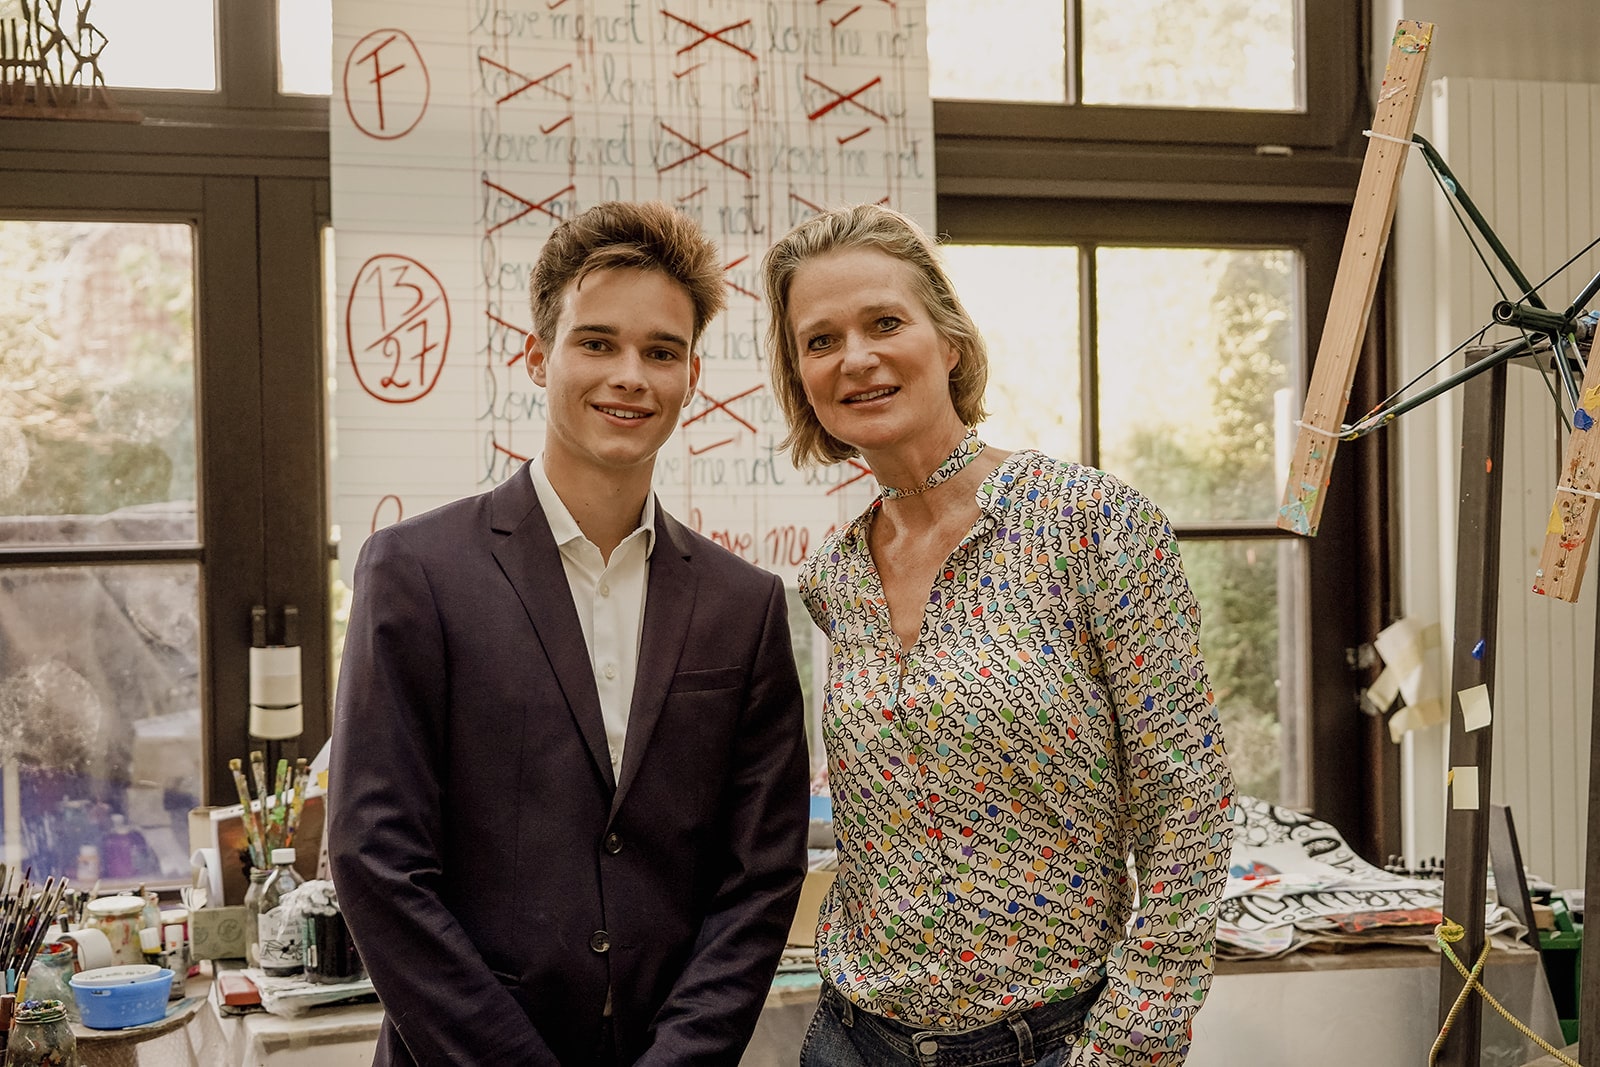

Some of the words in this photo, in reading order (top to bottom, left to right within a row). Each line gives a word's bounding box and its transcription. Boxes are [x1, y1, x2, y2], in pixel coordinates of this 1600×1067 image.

[592, 0, 644, 44] not
[356, 35, 405, 131] F
[718, 194, 766, 236] not
[474, 234, 534, 290] lov
[722, 319, 766, 361] not
[691, 458, 728, 486] me
[731, 434, 786, 486] not
[765, 524, 809, 566] me
